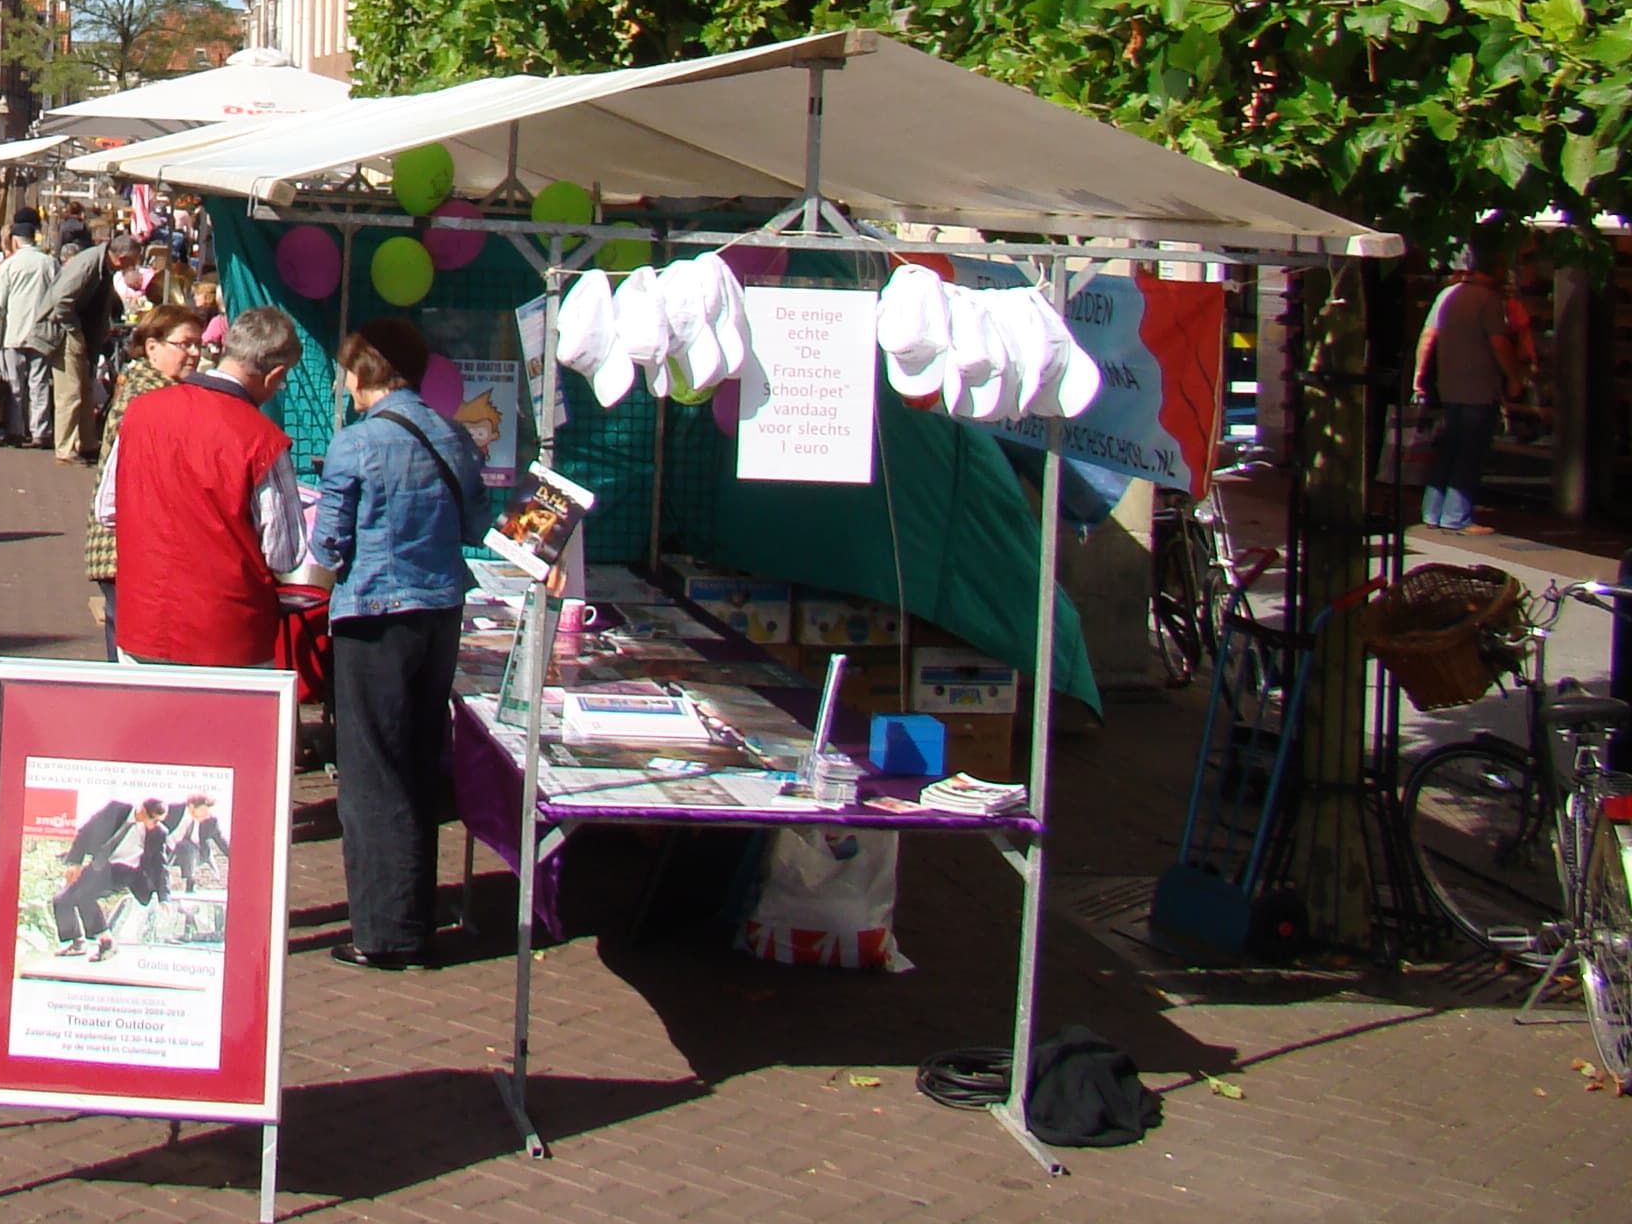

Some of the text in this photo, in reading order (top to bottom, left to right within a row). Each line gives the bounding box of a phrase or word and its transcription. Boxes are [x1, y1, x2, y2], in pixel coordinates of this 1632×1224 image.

[775, 306, 844, 324] De enige
[788, 326, 830, 341] echte
[772, 364, 842, 380] Fransche
[772, 403, 838, 420] vandaag
[758, 422, 851, 437] voor slechts
[779, 440, 829, 455] 1 euro
[137, 958, 216, 977] Gratis toegang
[66, 1014, 165, 1032] Theater Outdoor
[74, 1032, 117, 1043] september
